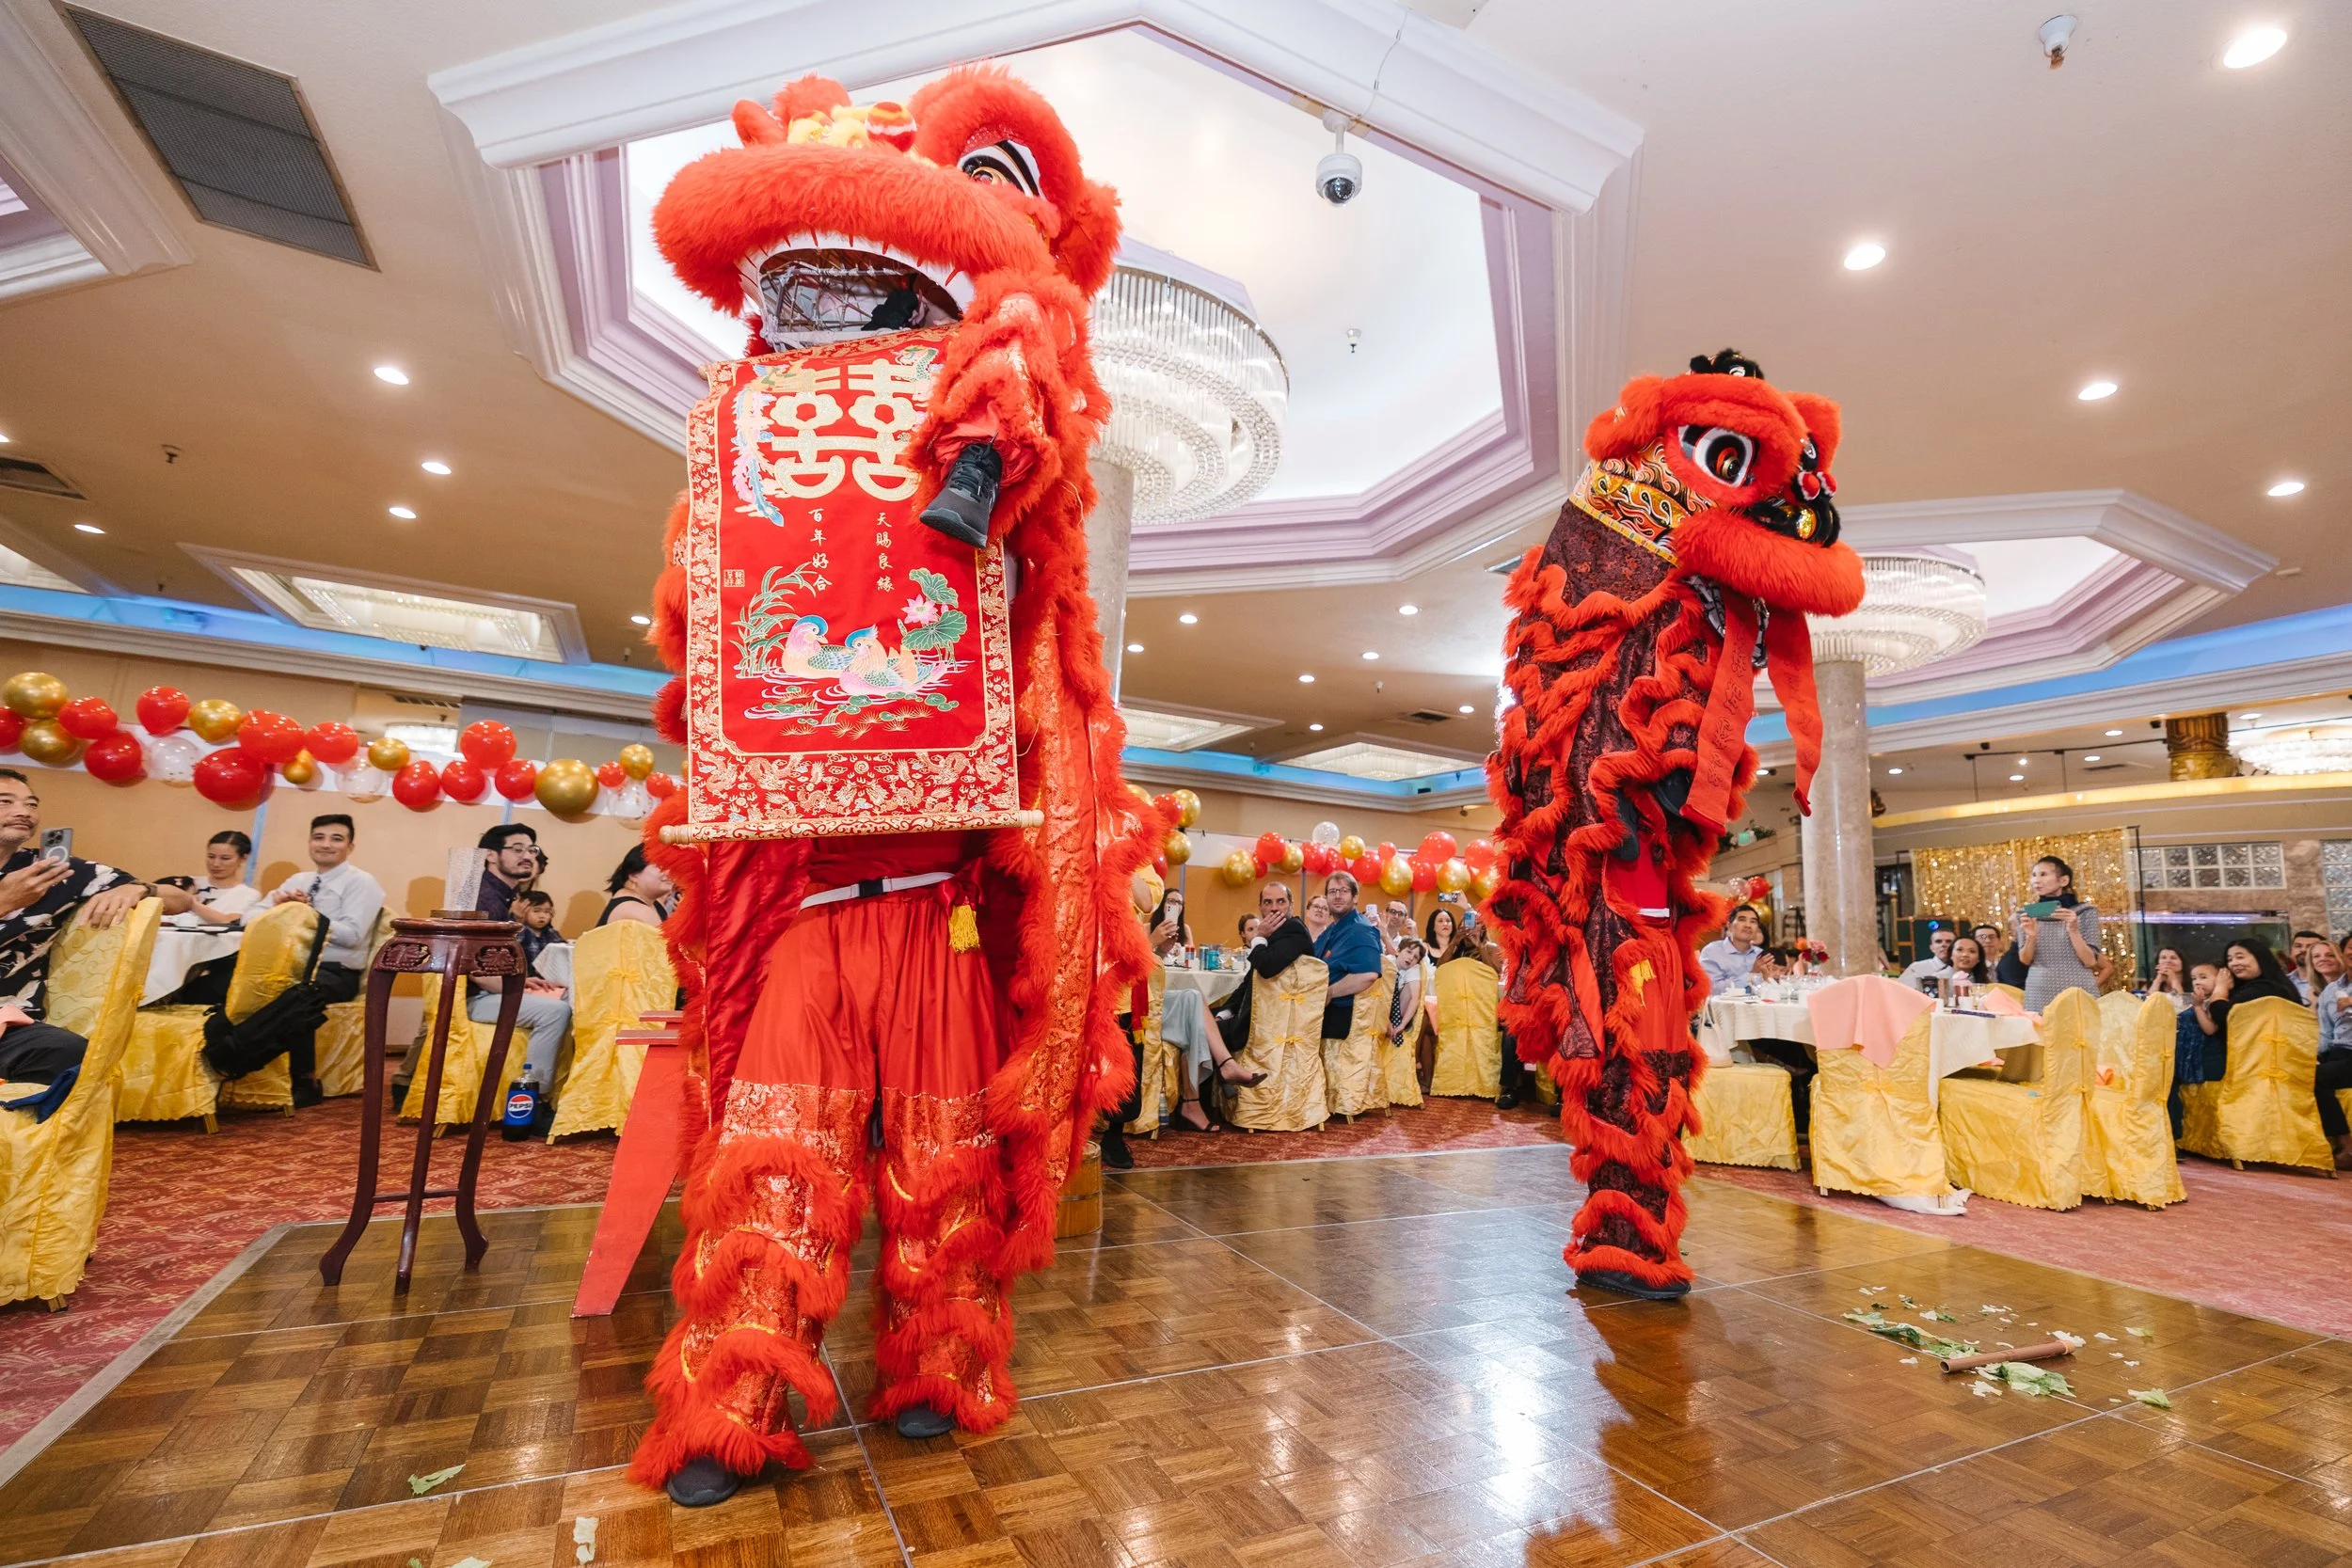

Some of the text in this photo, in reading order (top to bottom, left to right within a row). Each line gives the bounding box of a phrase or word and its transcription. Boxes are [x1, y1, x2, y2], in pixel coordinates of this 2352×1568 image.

[808, 508, 833, 592] 百年好合
[875, 512, 895, 593] 天賜良緣
